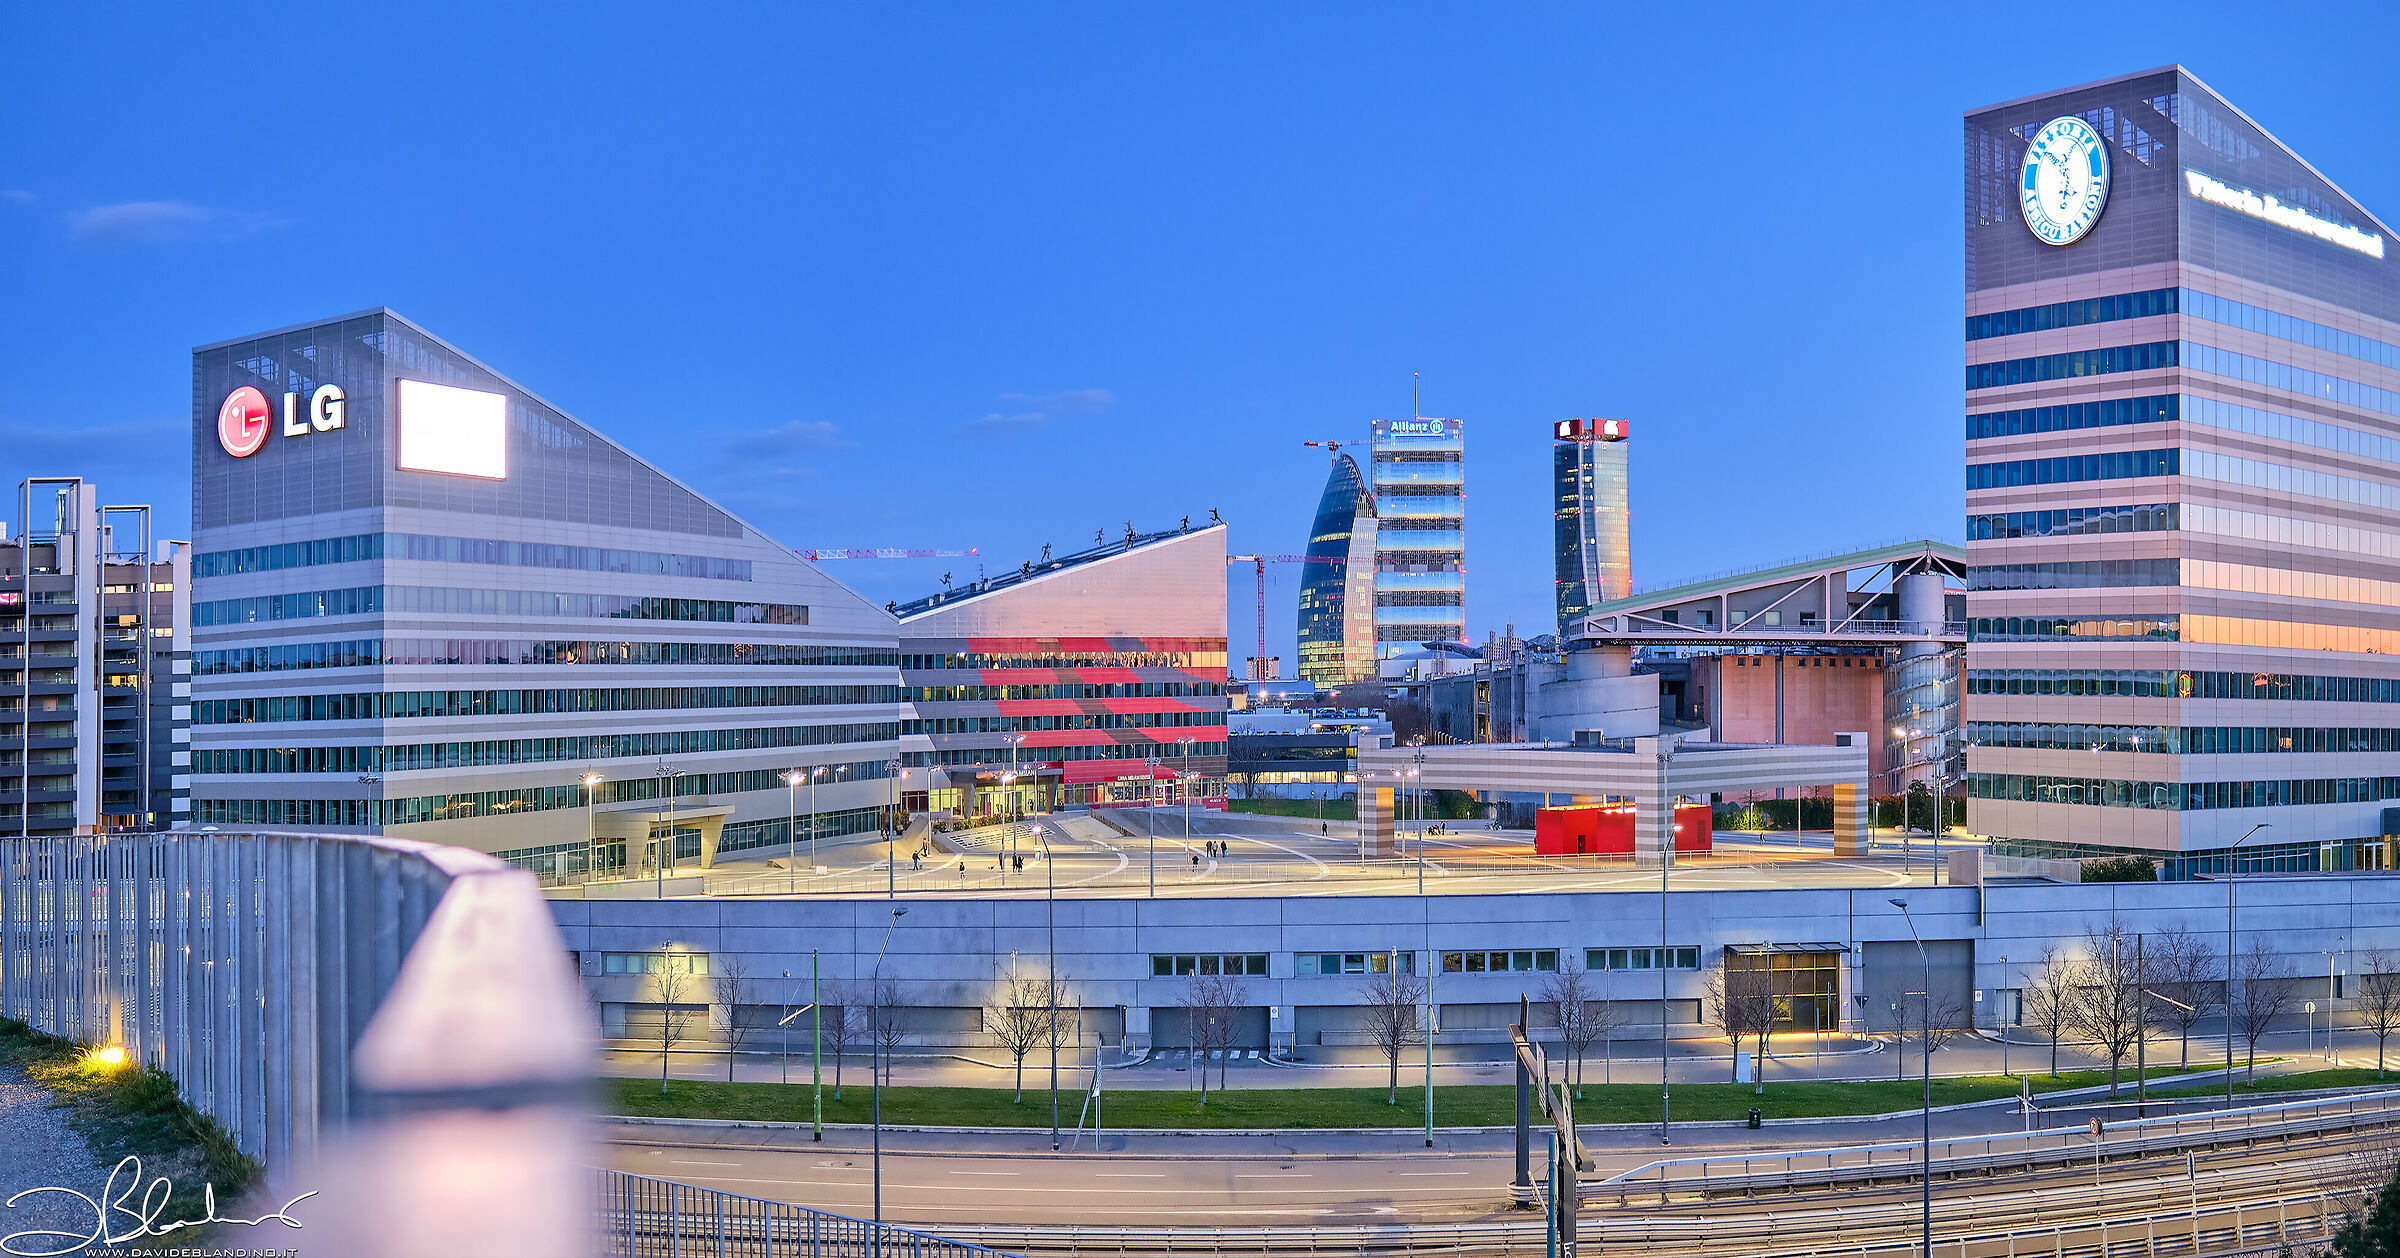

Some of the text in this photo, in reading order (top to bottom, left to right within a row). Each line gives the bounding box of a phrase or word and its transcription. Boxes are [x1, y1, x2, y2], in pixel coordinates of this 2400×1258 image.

[2027, 122, 2096, 165] VITTORIA
[283, 383, 345, 438] LG
[1391, 420, 1428, 433] Allianz
